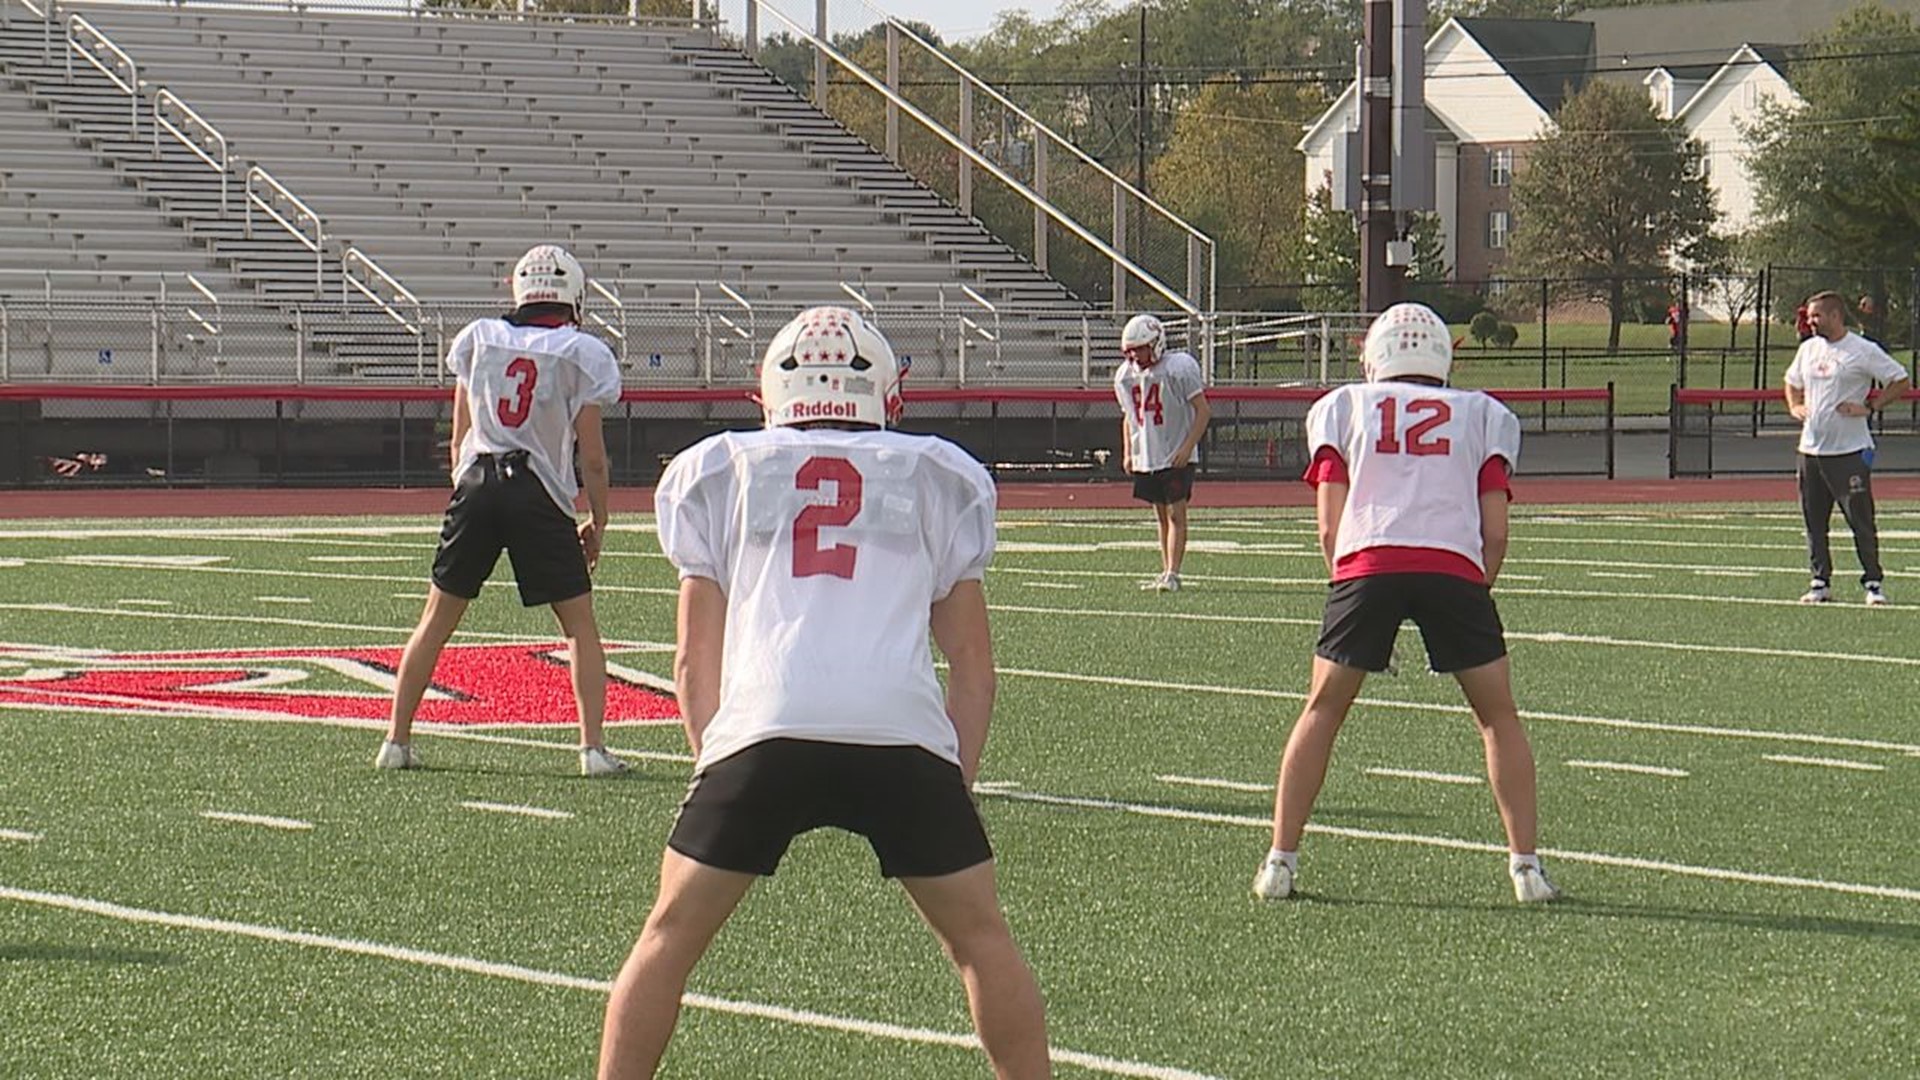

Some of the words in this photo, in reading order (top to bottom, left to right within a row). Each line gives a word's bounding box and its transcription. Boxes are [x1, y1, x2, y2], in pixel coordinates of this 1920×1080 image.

[498, 357, 537, 428] 3
[793, 402, 857, 417] Riddell
[1376, 397, 1451, 455] 12
[793, 457, 862, 579] 2
